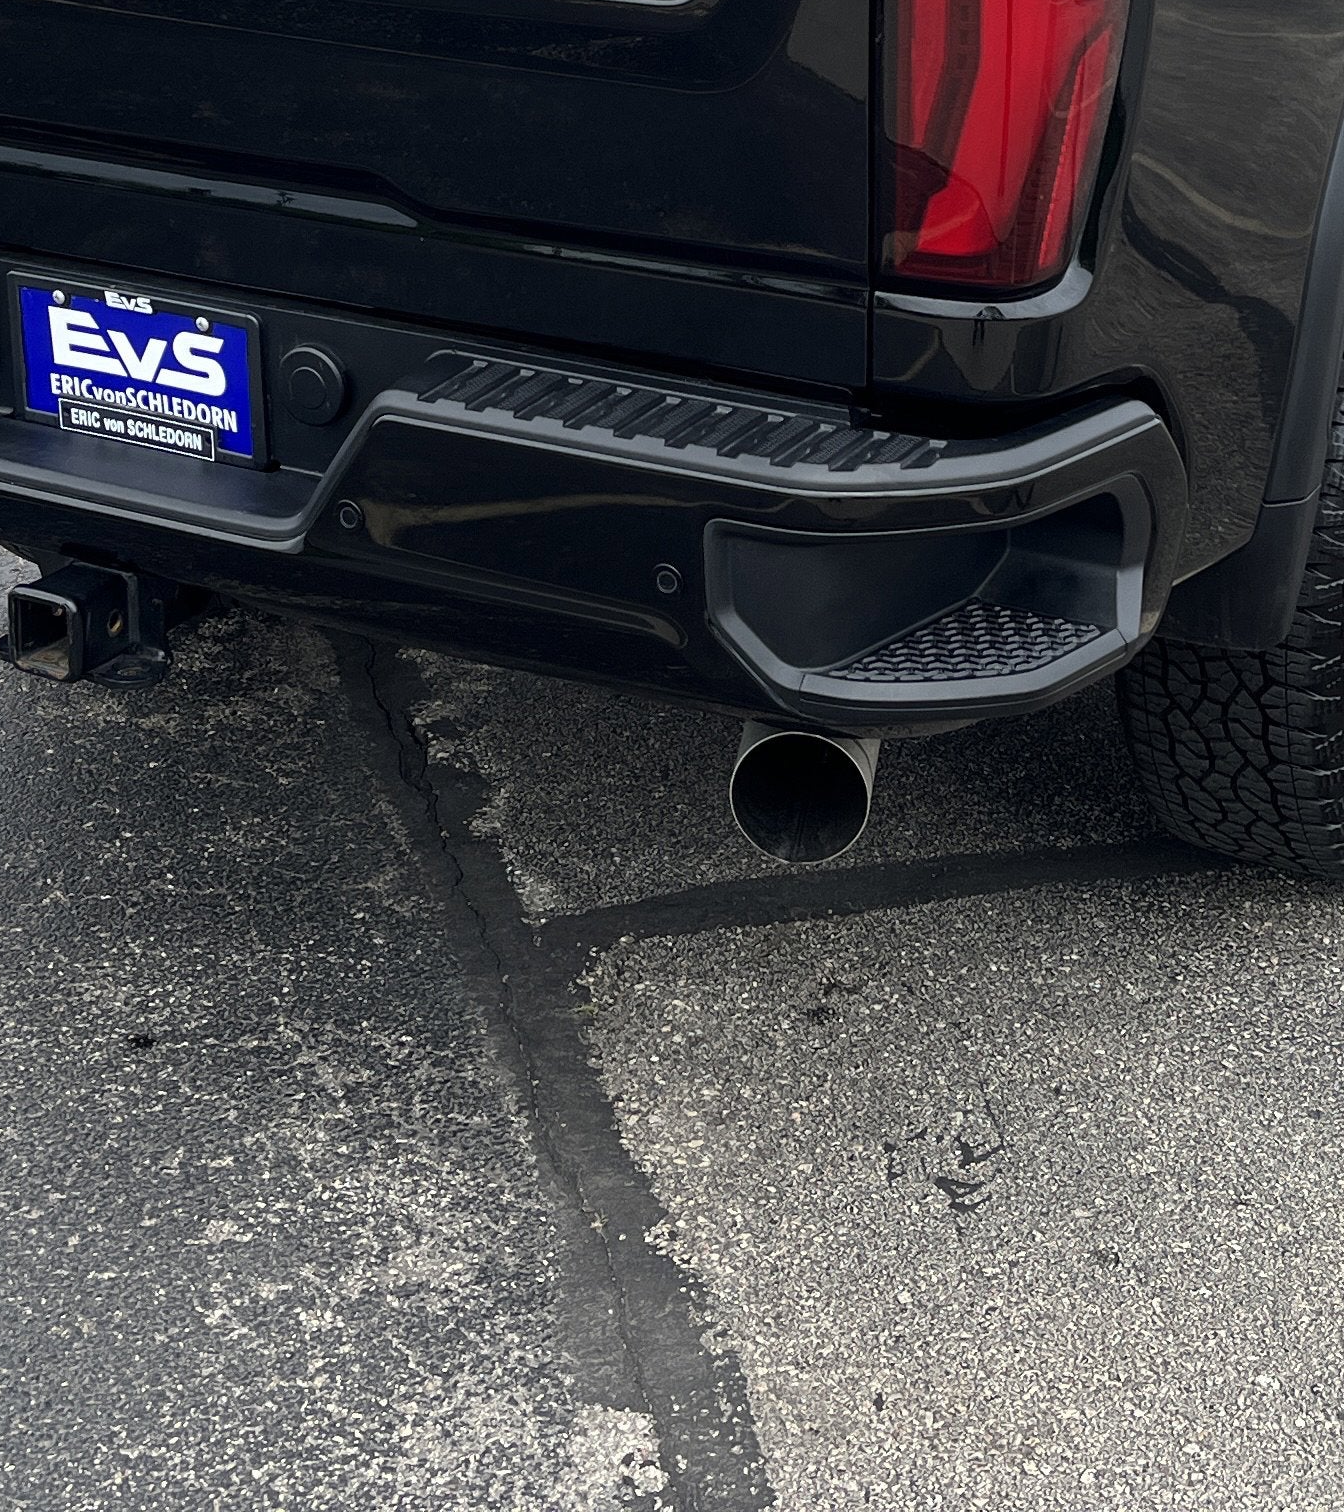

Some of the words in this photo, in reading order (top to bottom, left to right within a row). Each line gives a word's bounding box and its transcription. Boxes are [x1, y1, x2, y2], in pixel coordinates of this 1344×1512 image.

[70, 407, 101, 428] ERIC
[103, 416, 125, 434] von
[127, 421, 203, 451] SCHLEDORN
